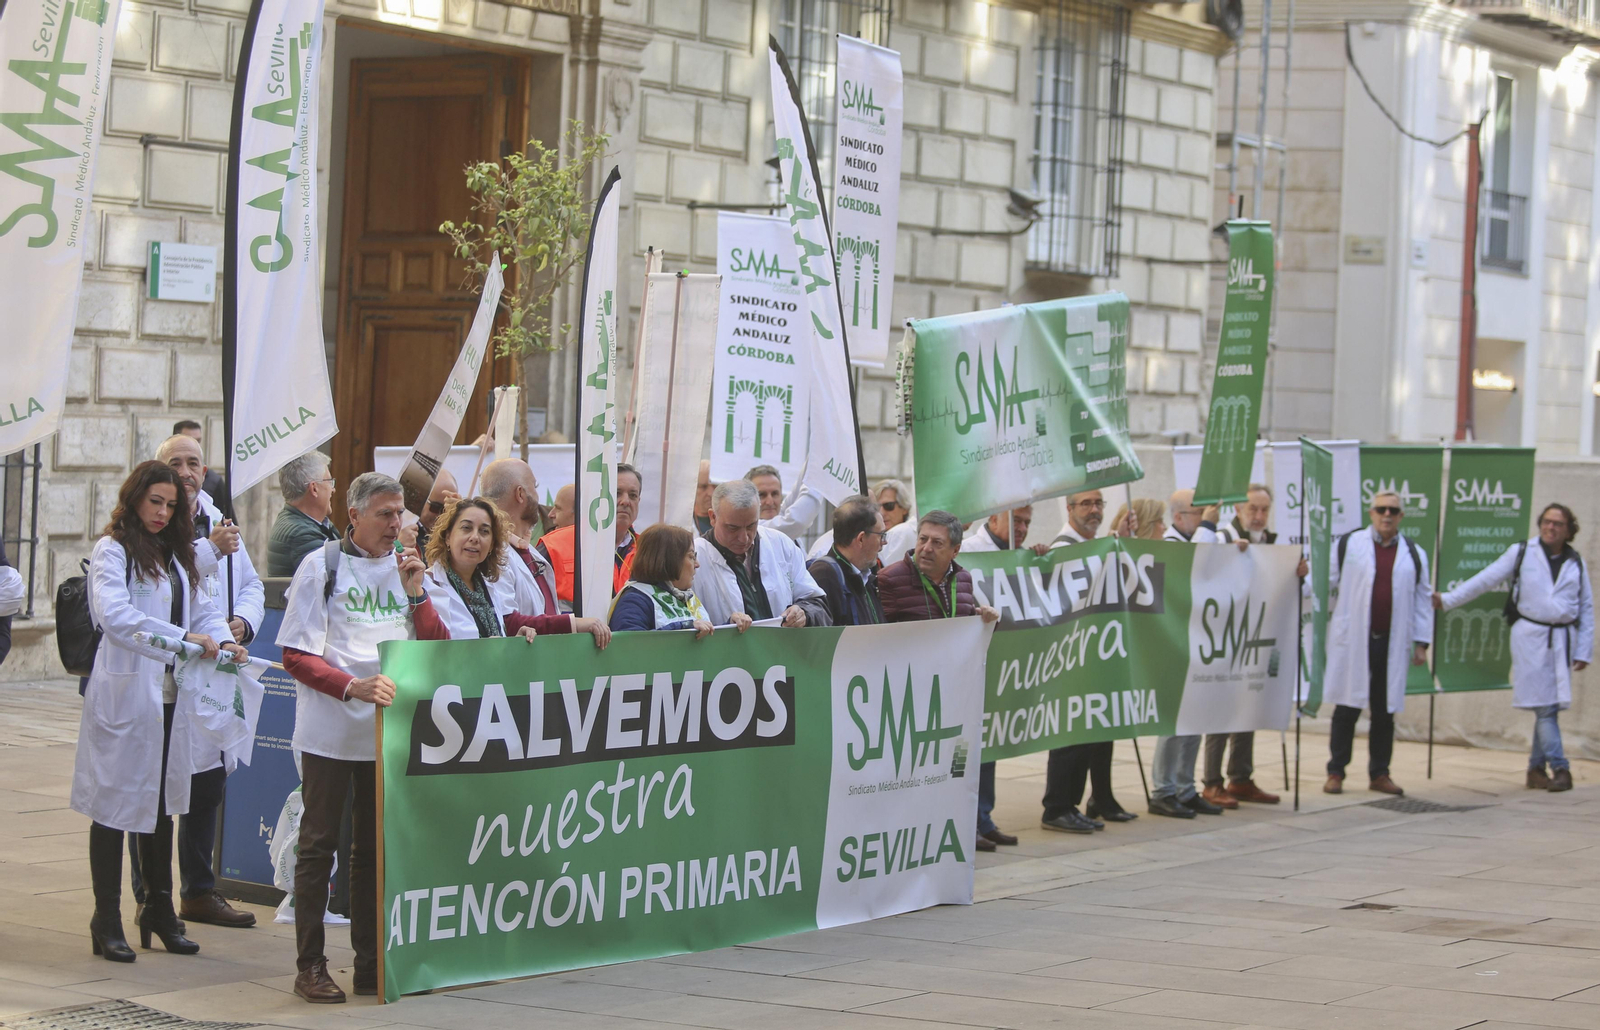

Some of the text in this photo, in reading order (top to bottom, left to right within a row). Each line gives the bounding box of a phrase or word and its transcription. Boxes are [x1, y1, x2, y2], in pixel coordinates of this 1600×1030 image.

[842, 79, 884, 118] SMA
[83, 105, 97, 149] Andaluz
[299, 124, 309, 166] Andaluz
[840, 135, 884, 156] SINDICATO
[75, 151, 91, 192] Médico
[845, 154, 877, 173] MÉDICO
[301, 168, 311, 208] Médico
[840, 174, 879, 193] ANDALUZ
[67, 197, 84, 247] Sindicato
[837, 194, 882, 217] CÓRDOBA
[730, 247, 796, 279] SMA
[1228, 255, 1265, 288] SMA
[730, 294, 798, 313] SINDICATO
[738, 310, 788, 328] MÉDICO
[732, 327, 792, 345] ANDALUZ
[727, 343, 796, 365] CÓRDOBA
[954, 339, 1039, 437] SMA
[235, 406, 317, 462] SEVILLA
[1019, 448, 1054, 471] Crdoba
[1086, 455, 1120, 474] SINDICATO
[1453, 477, 1519, 506] SMA
[1457, 526, 1514, 537] SINDICATO
[1463, 540, 1506, 554] MÉDICO
[344, 585, 409, 618] SMA
[1199, 592, 1277, 672] SMA
[996, 619, 1128, 697] nuestra
[421, 664, 789, 765] SALVEMOS
[847, 662, 964, 780] SMA
[848, 785, 876, 796] Sindicato
[878, 780, 900, 792] Médico
[899, 776, 921, 789] Andaluz
[468, 760, 696, 865] nuestra
[836, 818, 967, 883] SEVILLA
[387, 845, 803, 952] ATENCIÓN PRIMARIA
